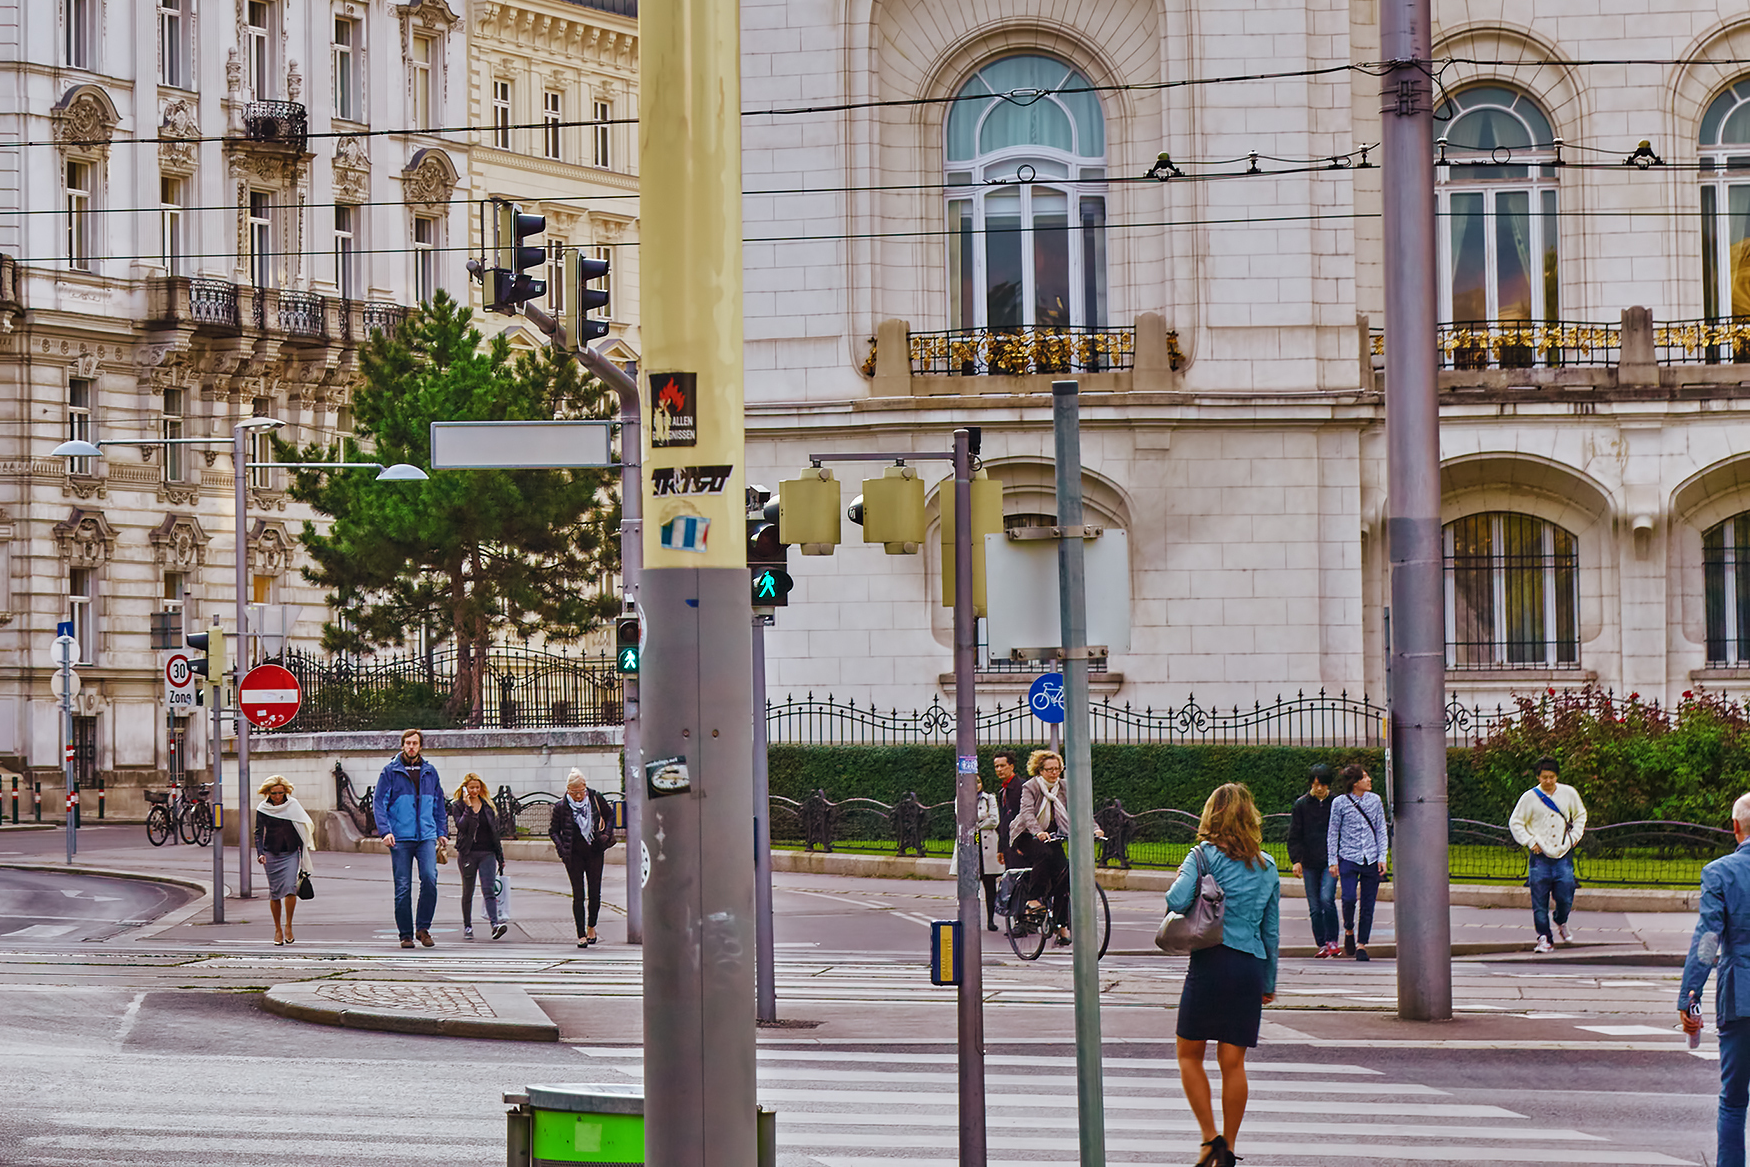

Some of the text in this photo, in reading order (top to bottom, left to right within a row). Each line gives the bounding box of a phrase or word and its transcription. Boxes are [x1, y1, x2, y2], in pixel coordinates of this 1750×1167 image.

[672, 415, 693, 427] ALLEN
[652, 429, 696, 442] GGNISSEN
[173, 663, 186, 679] 30
